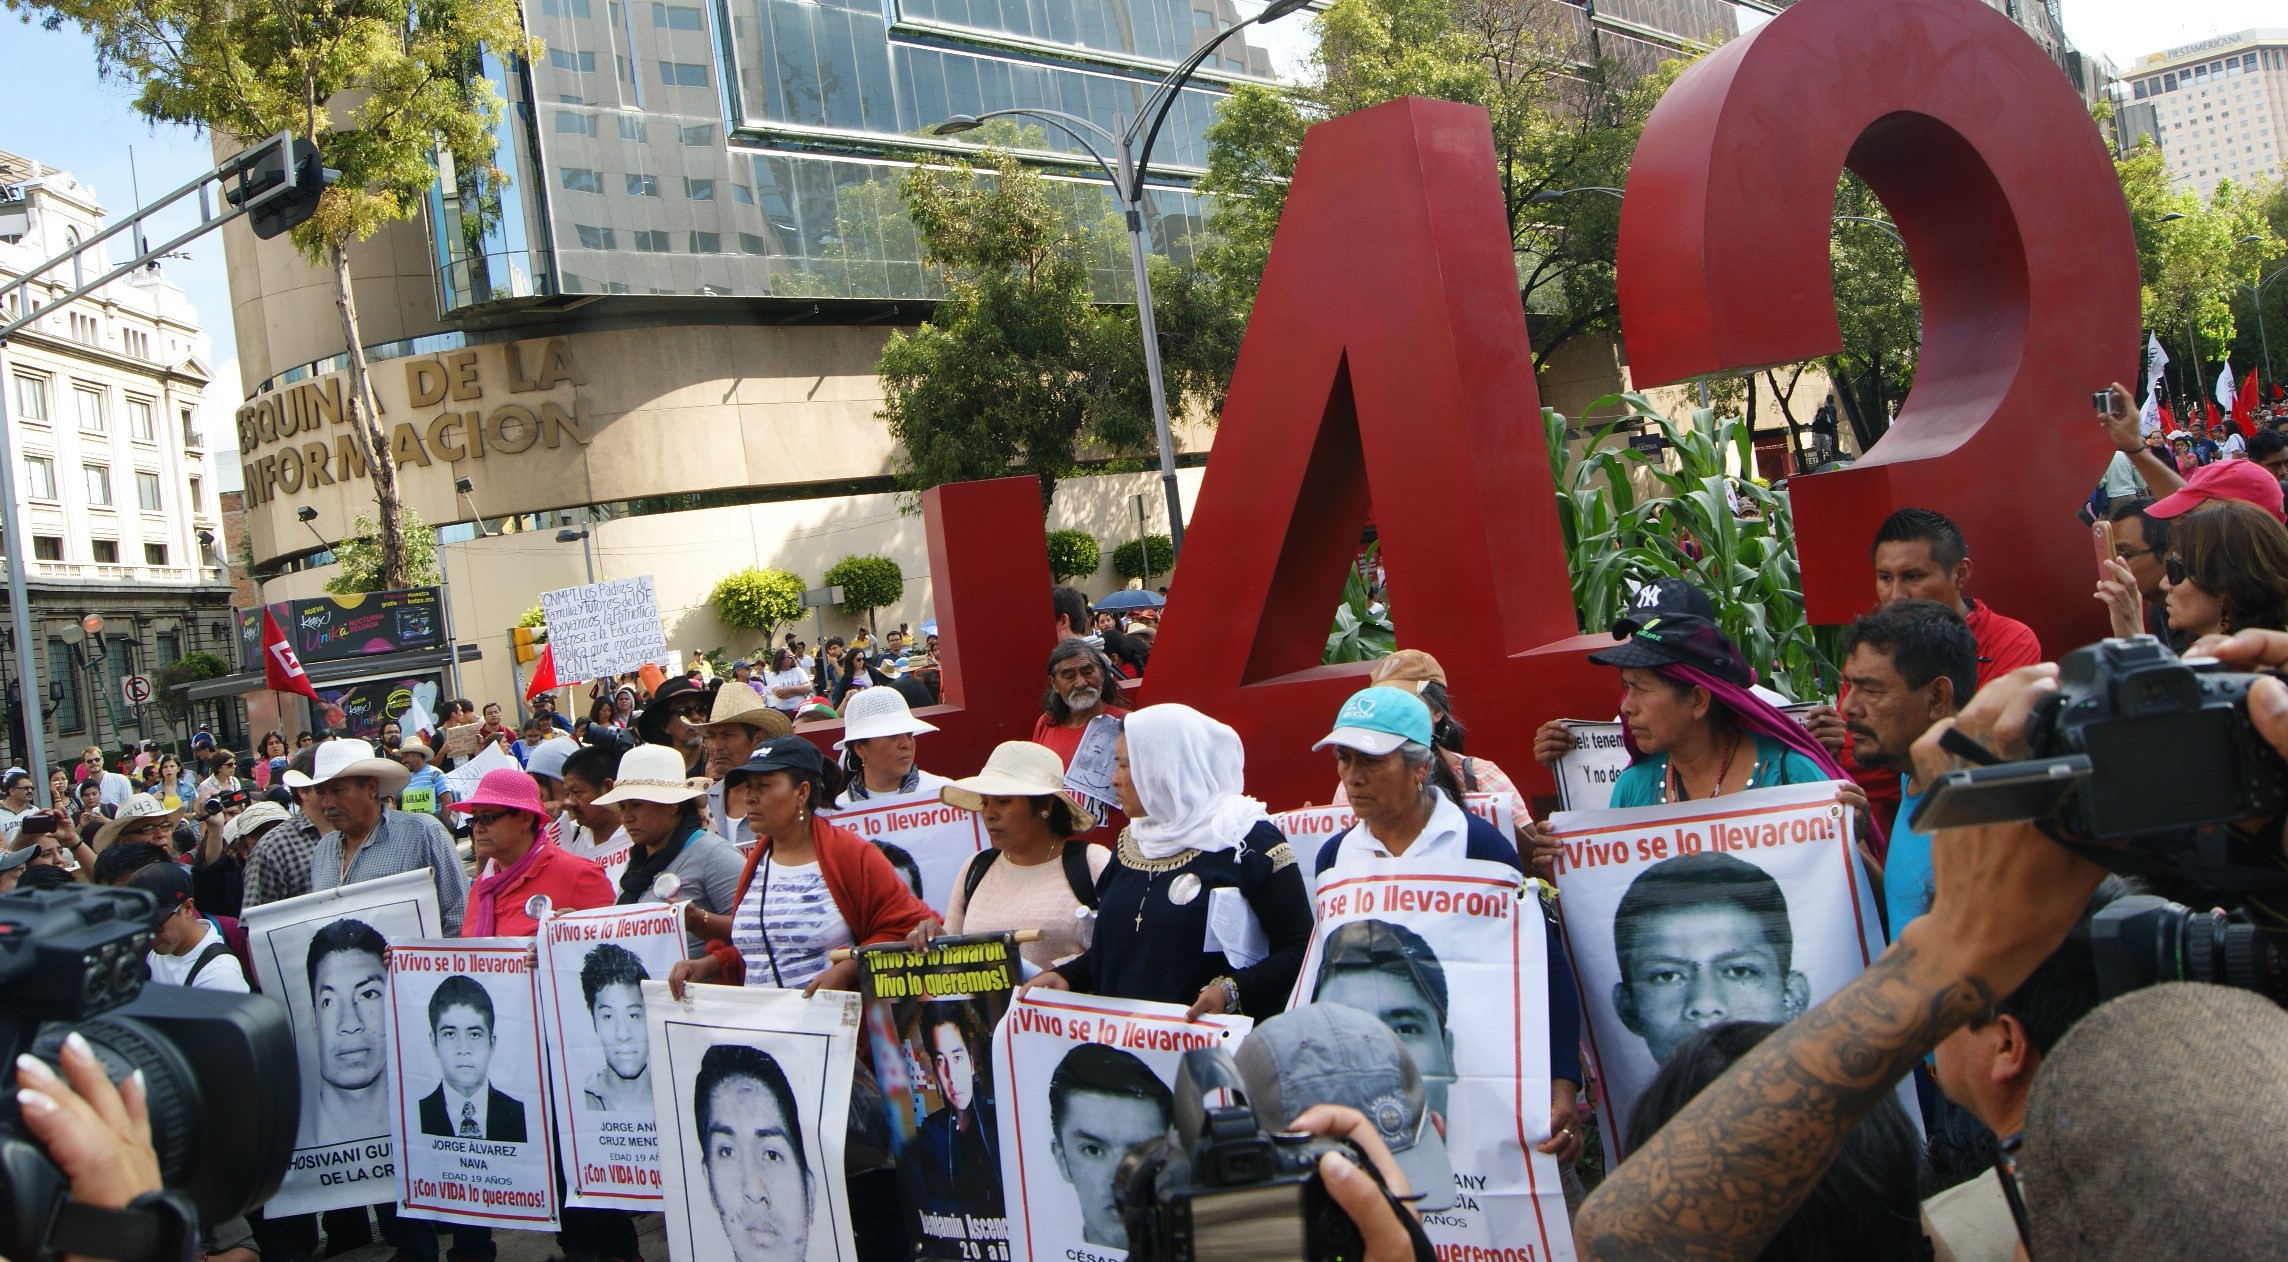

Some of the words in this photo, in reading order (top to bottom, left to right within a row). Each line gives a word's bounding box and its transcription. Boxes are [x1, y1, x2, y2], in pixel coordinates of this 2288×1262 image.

[404, 351, 482, 409] DE
[504, 340, 587, 394] LA
[242, 400, 593, 509] INFORMACION
[599, 580, 634, 597] Padres
[636, 576, 648, 590] de
[304, 605, 325, 616] NUEVA
[348, 613, 385, 626] NOCTURNA
[348, 621, 380, 633] DELGADA
[549, 614, 601, 636] Apoyamos
[589, 631, 597, 642] a
[610, 617, 660, 638] Educación
[590, 641, 610, 658] que
[565, 653, 598, 675] CNTE
[1582, 765, 1591, 784] Y
[1593, 769, 1607, 784] no
[133, 800, 153, 814] 43
[864, 816, 882, 836] lo
[1340, 813, 1361, 830] se
[1639, 835, 1668, 862] se
[1674, 827, 1703, 857] lo
[1710, 812, 1837, 854] llevaron!
[1328, 897, 1347, 920] se
[1354, 886, 1375, 914] lo
[1383, 884, 1509, 920] llevaron!
[550, 921, 581, 946] ¡Vivo
[583, 924, 598, 941] se
[600, 920, 613, 940] lo
[615, 916, 677, 939] llevaron!
[393, 953, 431, 974] ¡Vivo
[434, 956, 449, 972] se
[453, 953, 466, 973] lo
[469, 953, 529, 975] llevaron!
[906, 951, 925, 968] se
[874, 973, 907, 998] Vivo
[906, 971, 924, 996] lo
[924, 964, 1011, 997] queremos!
[1013, 1007, 1063, 1037] ¡Vivo
[1069, 1019, 1091, 1042] se
[1097, 1017, 1117, 1047] lo
[600, 1121, 634, 1133] JORGE
[431, 1138, 467, 1153] JORGE
[468, 1139, 518, 1157] ÁLVAREZ
[599, 1134, 627, 1147] CRUZ
[287, 1146, 361, 1171] HOSIVANI
[459, 1157, 488, 1170] NAVA
[609, 1151, 632, 1162] EDAD
[635, 1153, 646, 1162] 19
[320, 1170, 344, 1187] DE
[346, 1167, 369, 1183] LA
[372, 1163, 395, 1179] CR
[442, 1171, 468, 1182] EDAD
[471, 1174, 482, 1183] 19
[484, 1174, 513, 1187] AÑOS
[584, 1163, 607, 1186] ¡Con
[609, 1164, 634, 1185] VIDA
[635, 1167, 647, 1186] lo
[414, 1178, 437, 1199] ¡Con
[438, 1181, 466, 1202] VIDA
[468, 1185, 479, 1203] lo
[482, 1188, 546, 1209] queremos!
[1423, 1211, 1468, 1229] AÑOS
[959, 1240, 982, 1261] 20
[987, 1241, 1009, 1262] añ
